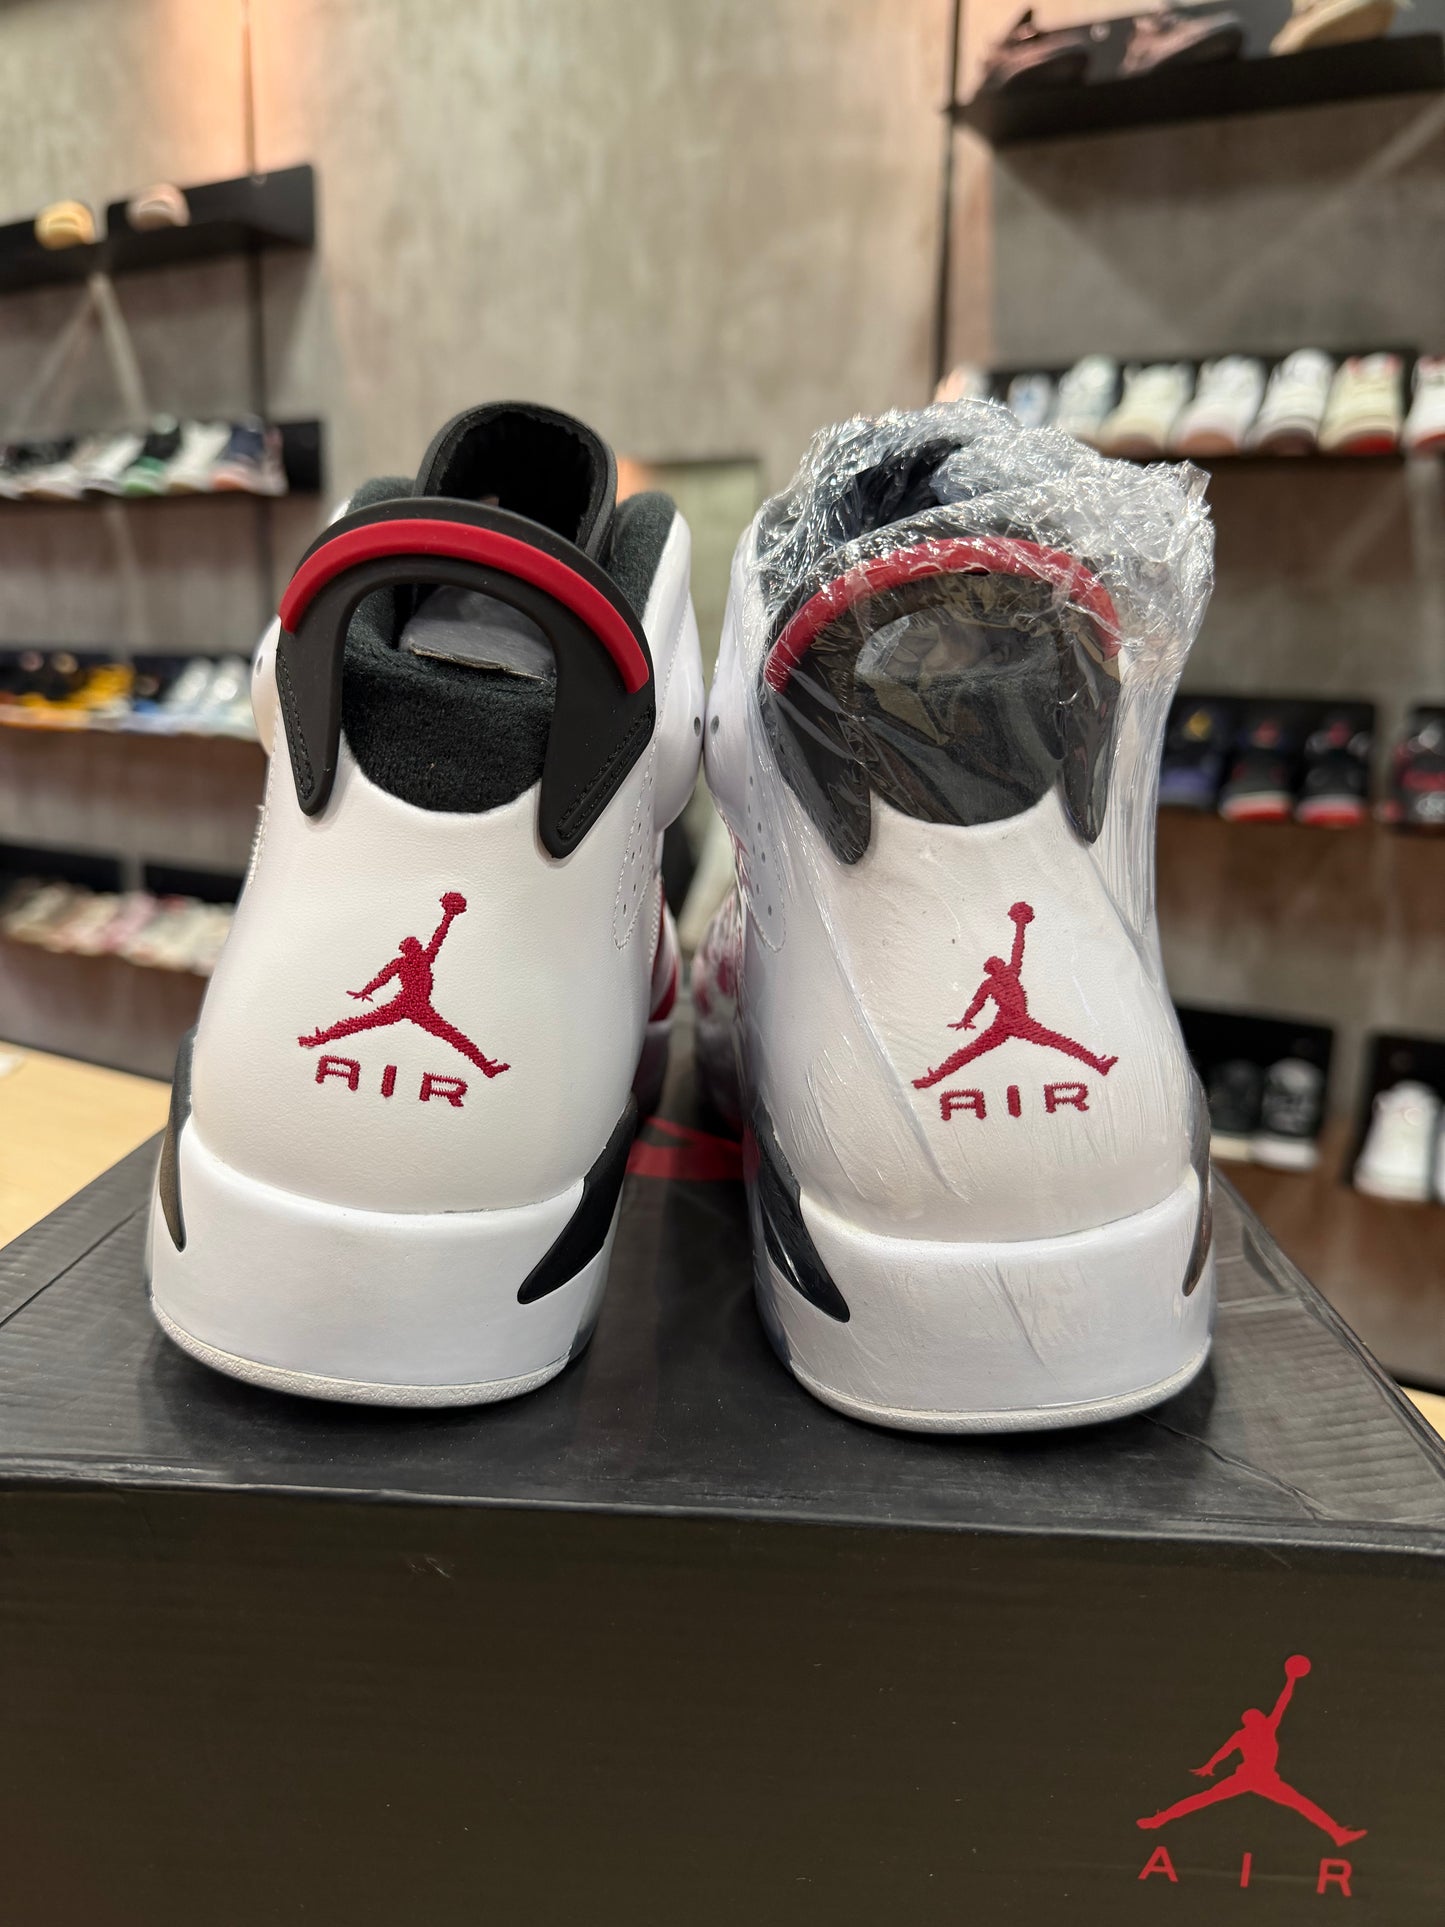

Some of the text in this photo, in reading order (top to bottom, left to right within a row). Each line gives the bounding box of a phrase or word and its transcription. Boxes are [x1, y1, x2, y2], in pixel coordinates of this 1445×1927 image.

[316, 1056, 467, 1107] AIR
[941, 1083, 1089, 1120] AIR
[1138, 1846, 1353, 1897] AIR
